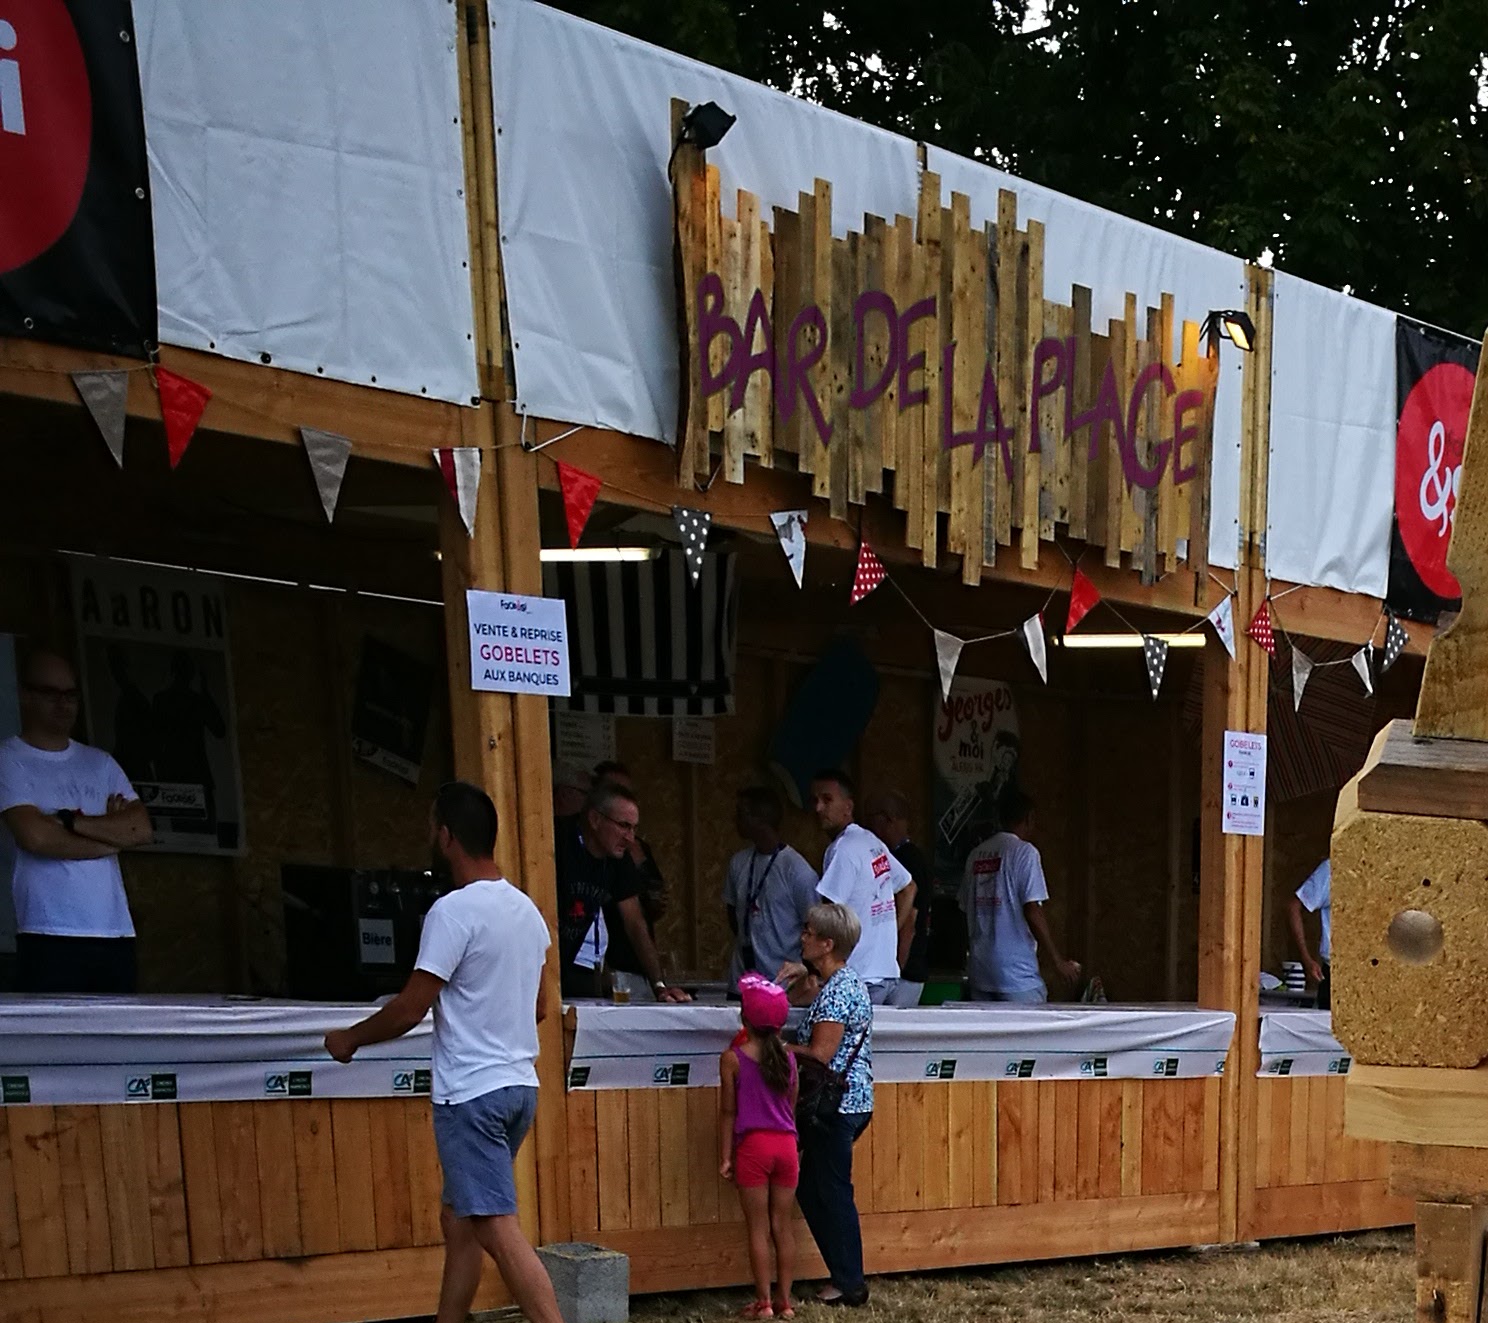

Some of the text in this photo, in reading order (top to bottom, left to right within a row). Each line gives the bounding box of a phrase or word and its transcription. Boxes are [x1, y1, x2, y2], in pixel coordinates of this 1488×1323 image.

[699, 272, 1205, 497] BAR DE LA PLAGE
[474, 623, 562, 642] VENTE & REPRISE
[480, 644, 560, 667] GOBELETS
[484, 668, 559, 686] AUX BANQUES
[959, 741, 984, 759] moi
[362, 932, 392, 945] Bière
